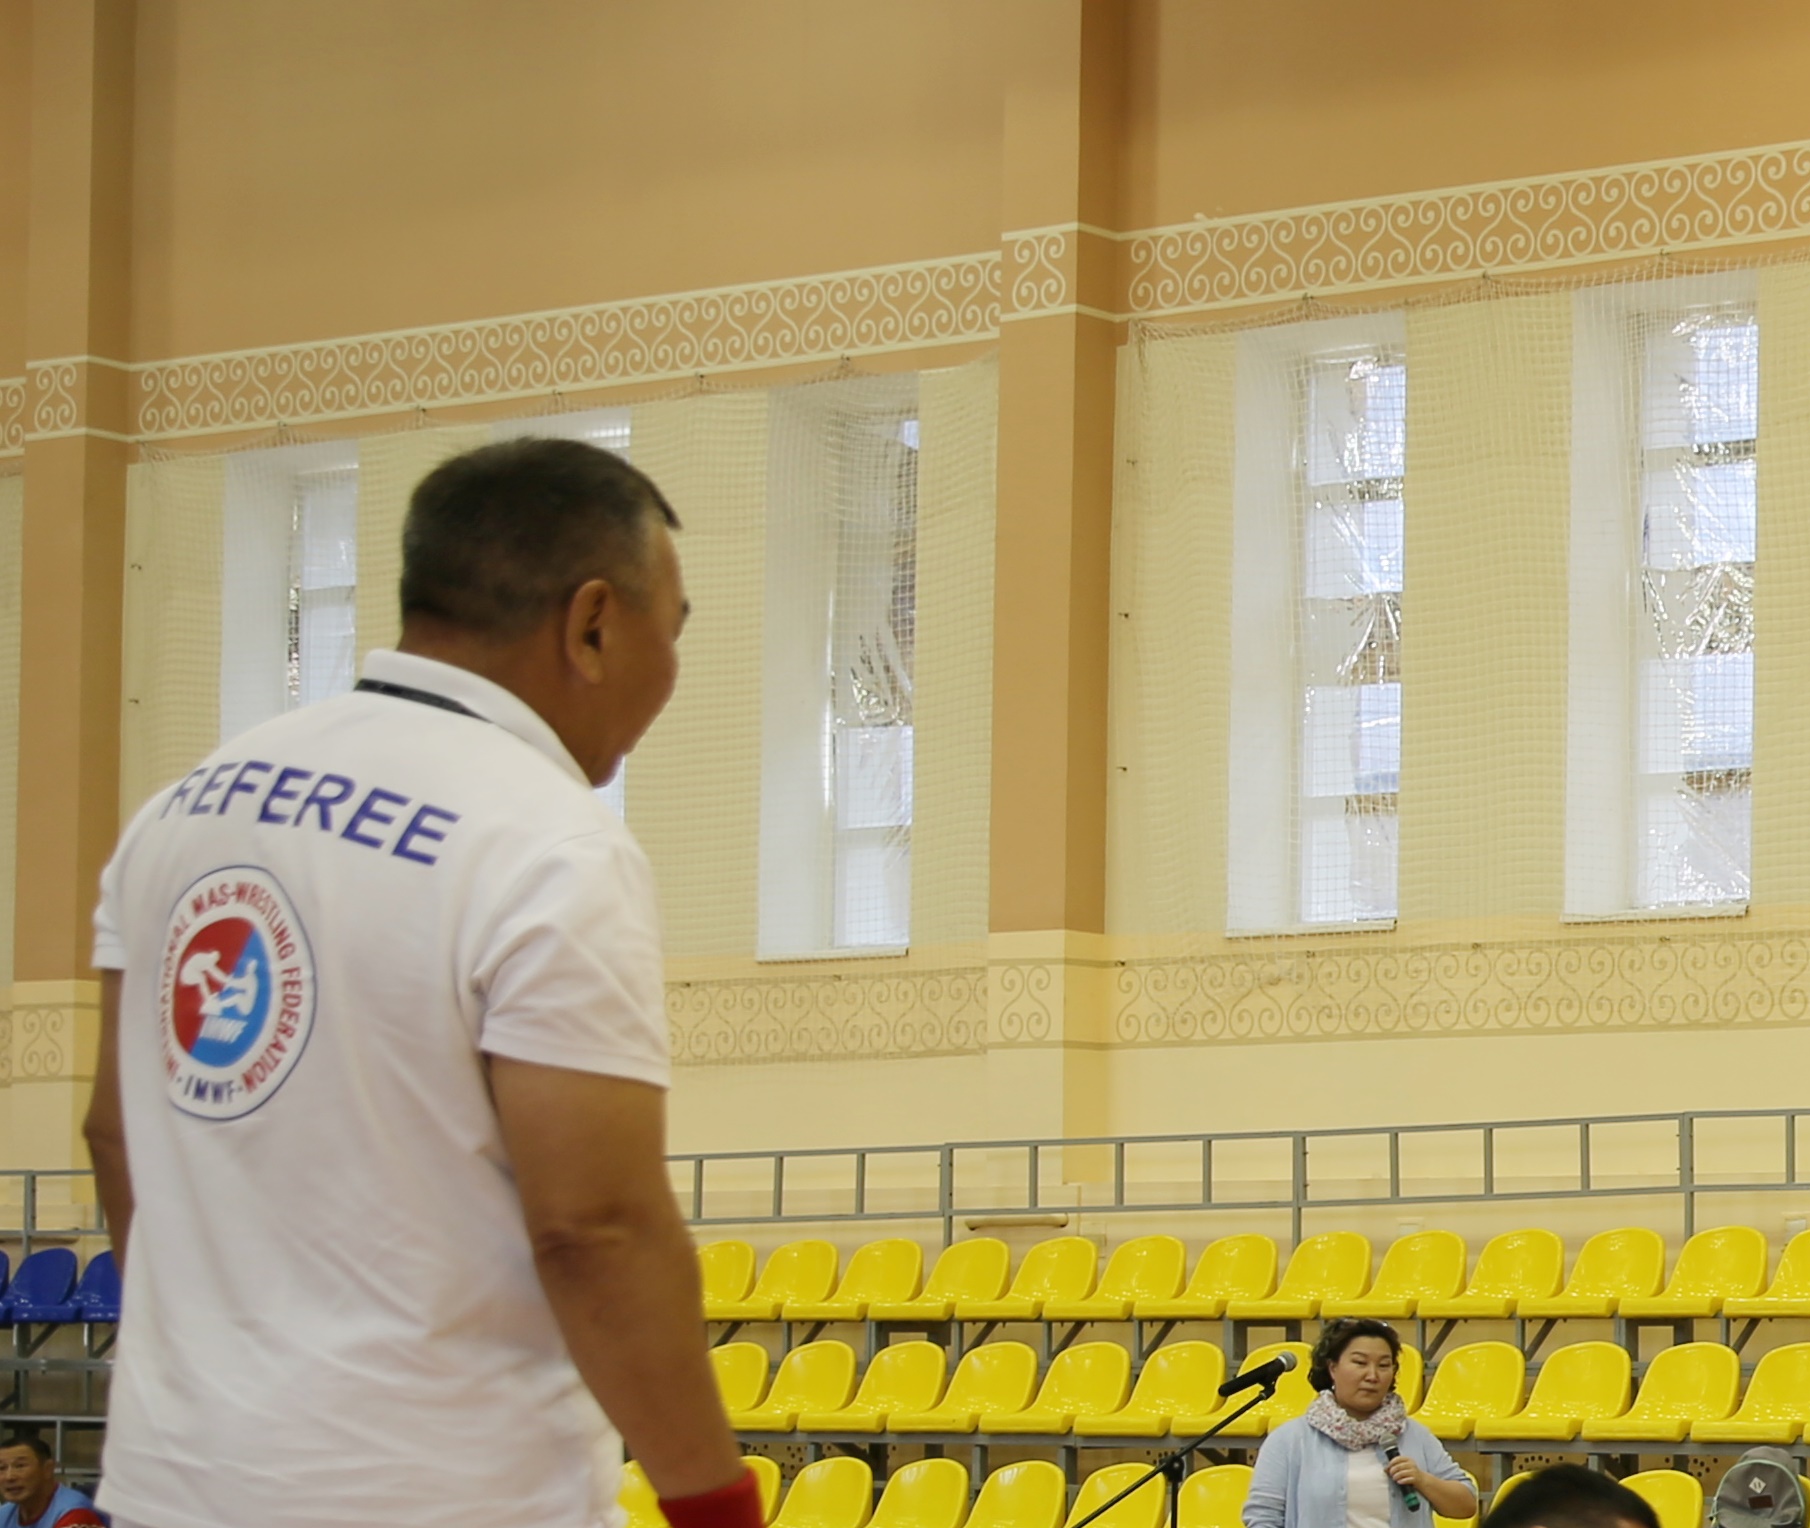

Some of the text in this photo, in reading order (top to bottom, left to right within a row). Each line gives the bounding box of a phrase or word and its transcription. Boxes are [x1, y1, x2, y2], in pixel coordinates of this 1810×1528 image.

[160, 759, 462, 867] REFEREE
[191, 880, 295, 961] MAS-WRESTLING
[241, 965, 303, 1094] FEDERATION
[184, 1075, 236, 1104] IMWF
